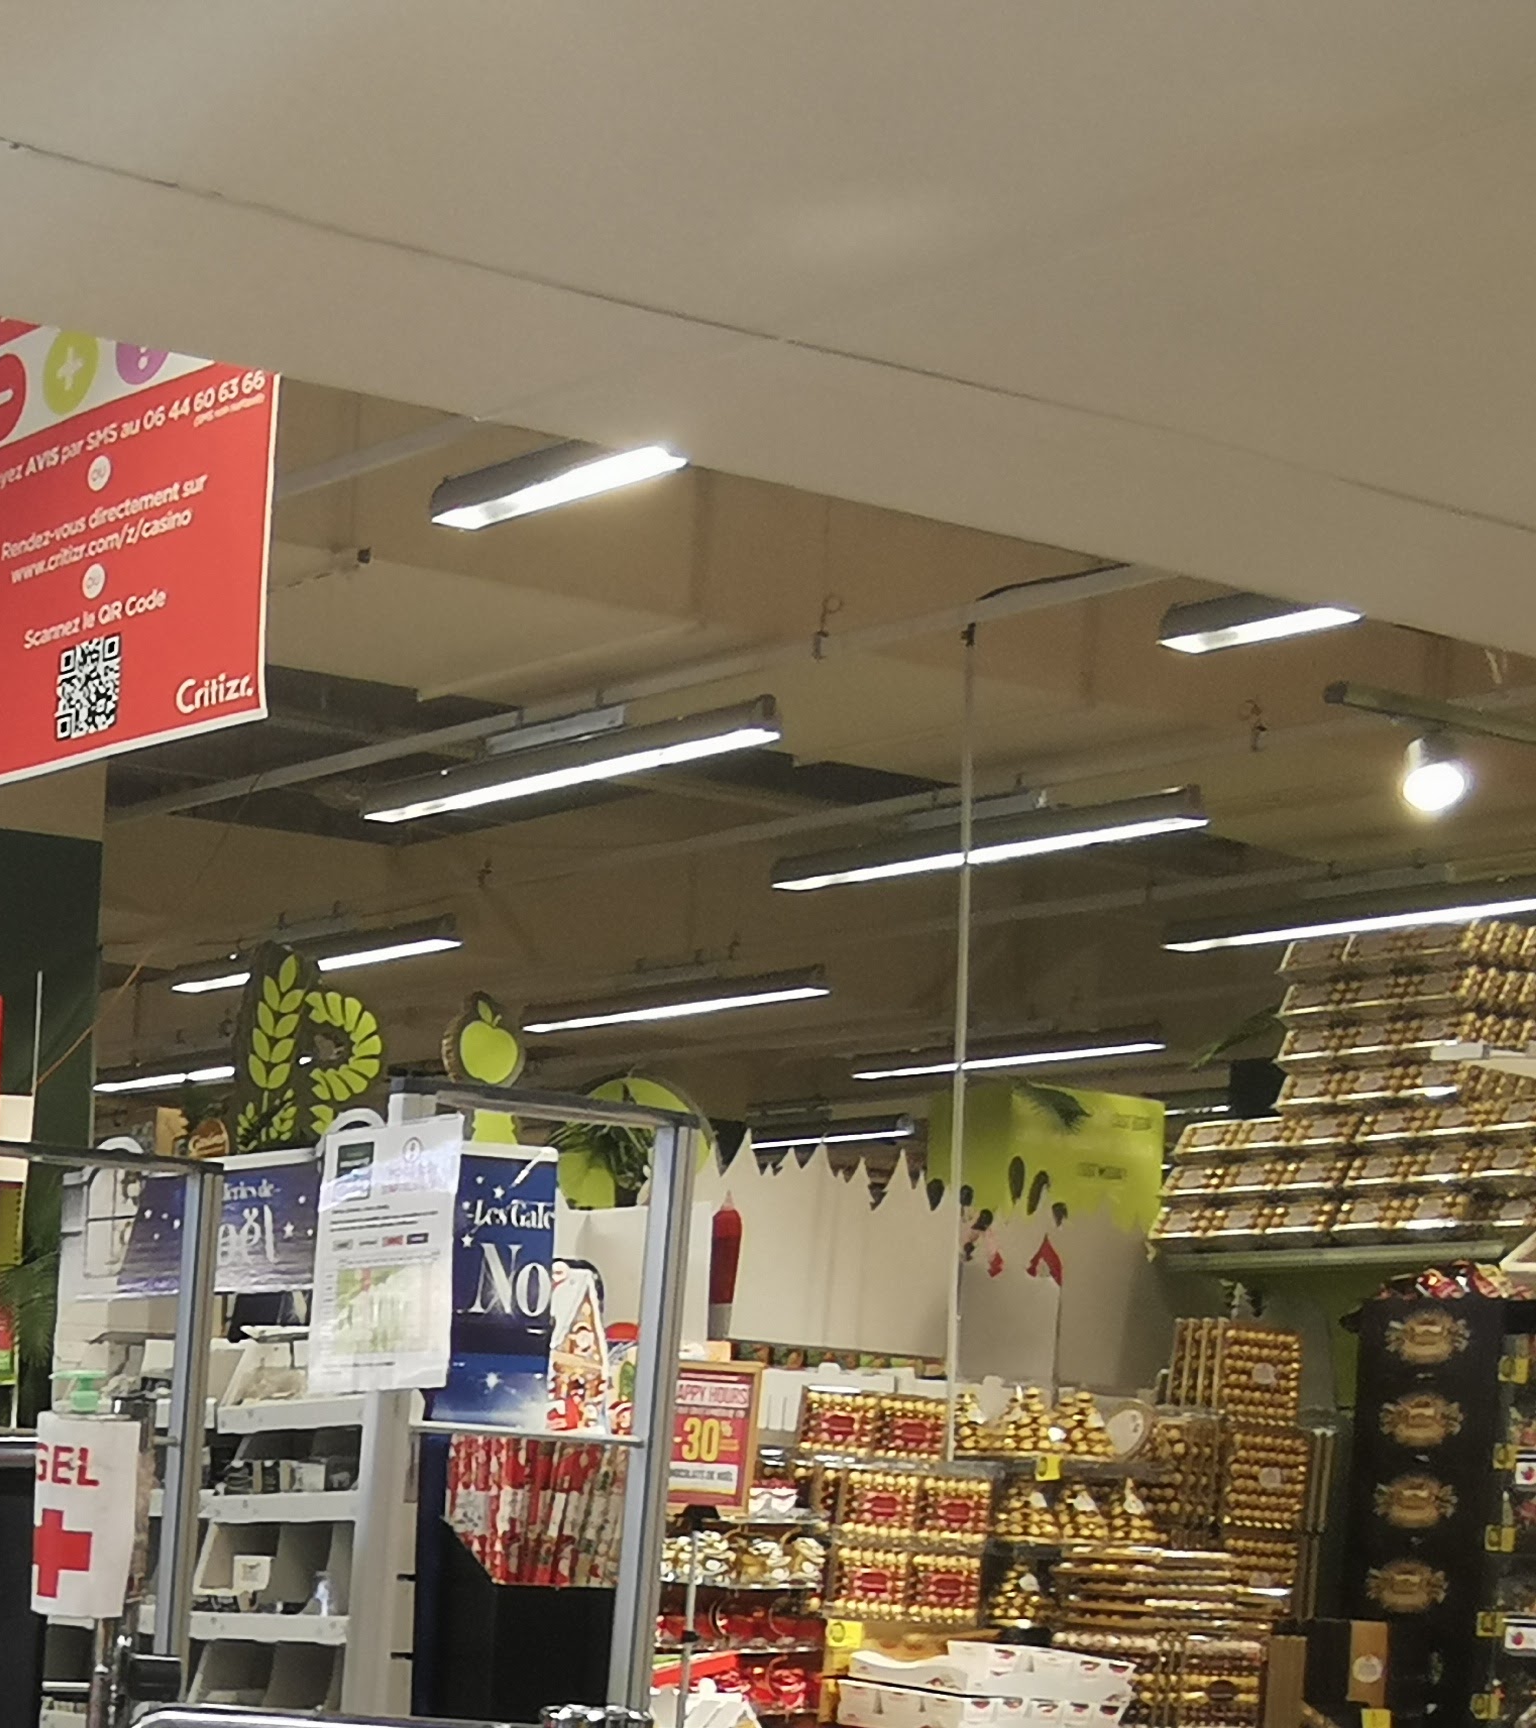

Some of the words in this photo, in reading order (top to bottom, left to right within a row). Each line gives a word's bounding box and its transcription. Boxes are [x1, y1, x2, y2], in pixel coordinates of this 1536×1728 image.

[25, 445, 60, 477] AVIS
[61, 440, 84, 465] par
[86, 422, 118, 451] SMS
[120, 418, 141, 439] au
[143, 405, 166, 430] 06
[168, 396, 191, 420] 44
[193, 387, 215, 412] 60
[218, 376, 240, 402] 63
[241, 369, 266, 394] 66
[1, 516, 86, 561] Rendez-vous
[88, 482, 180, 528] directement
[182, 475, 208, 498] sur
[24, 617, 80, 649] Scannez
[82, 611, 96, 630] le
[98, 601, 123, 624] QR
[125, 589, 167, 617] Code
[36, 1441, 100, 1487] GEL
